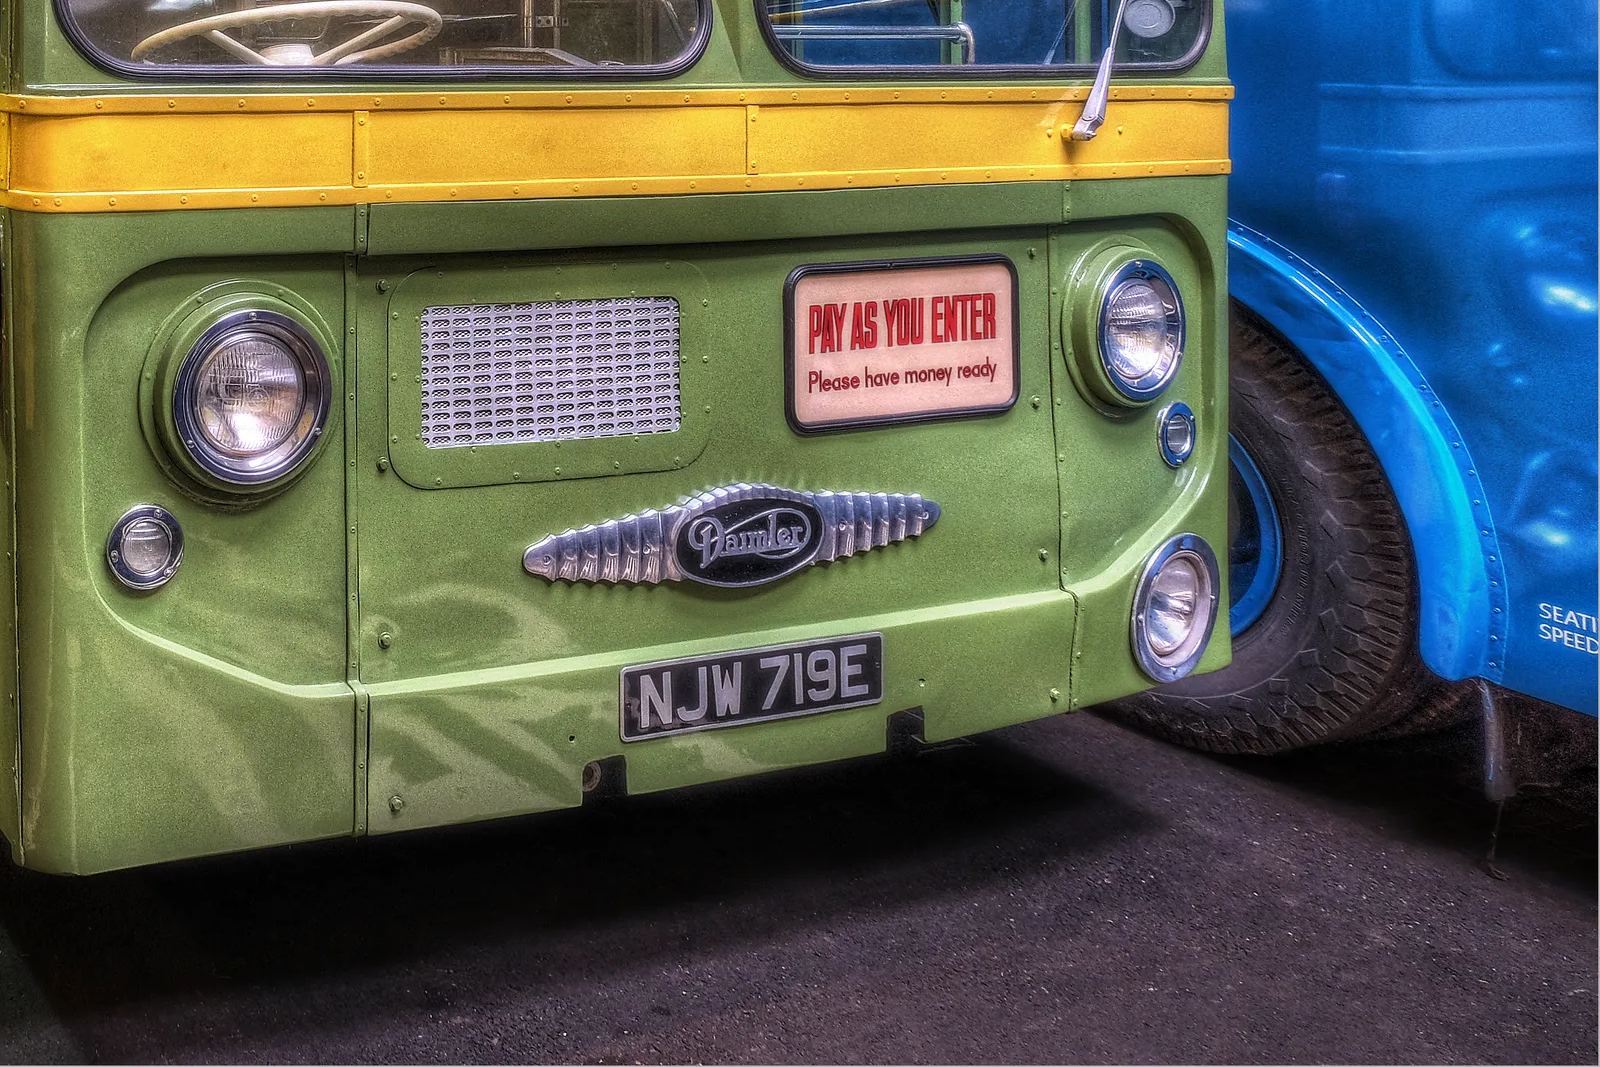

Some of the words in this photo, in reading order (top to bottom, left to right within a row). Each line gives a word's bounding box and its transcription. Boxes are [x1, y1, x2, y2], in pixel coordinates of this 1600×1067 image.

[809, 303, 847, 354] PAY
[850, 301, 878, 350] AS
[884, 297, 924, 347] YOU
[931, 292, 997, 344] ENTER
[808, 370, 860, 394] Please
[864, 366, 900, 388] have
[905, 366, 952, 387] money
[957, 356, 997, 383] ready
[689, 508, 811, 569] Daimler
[1538, 623, 1598, 655] SPEED
[639, 661, 742, 730] NJW
[760, 644, 869, 711] 719E
